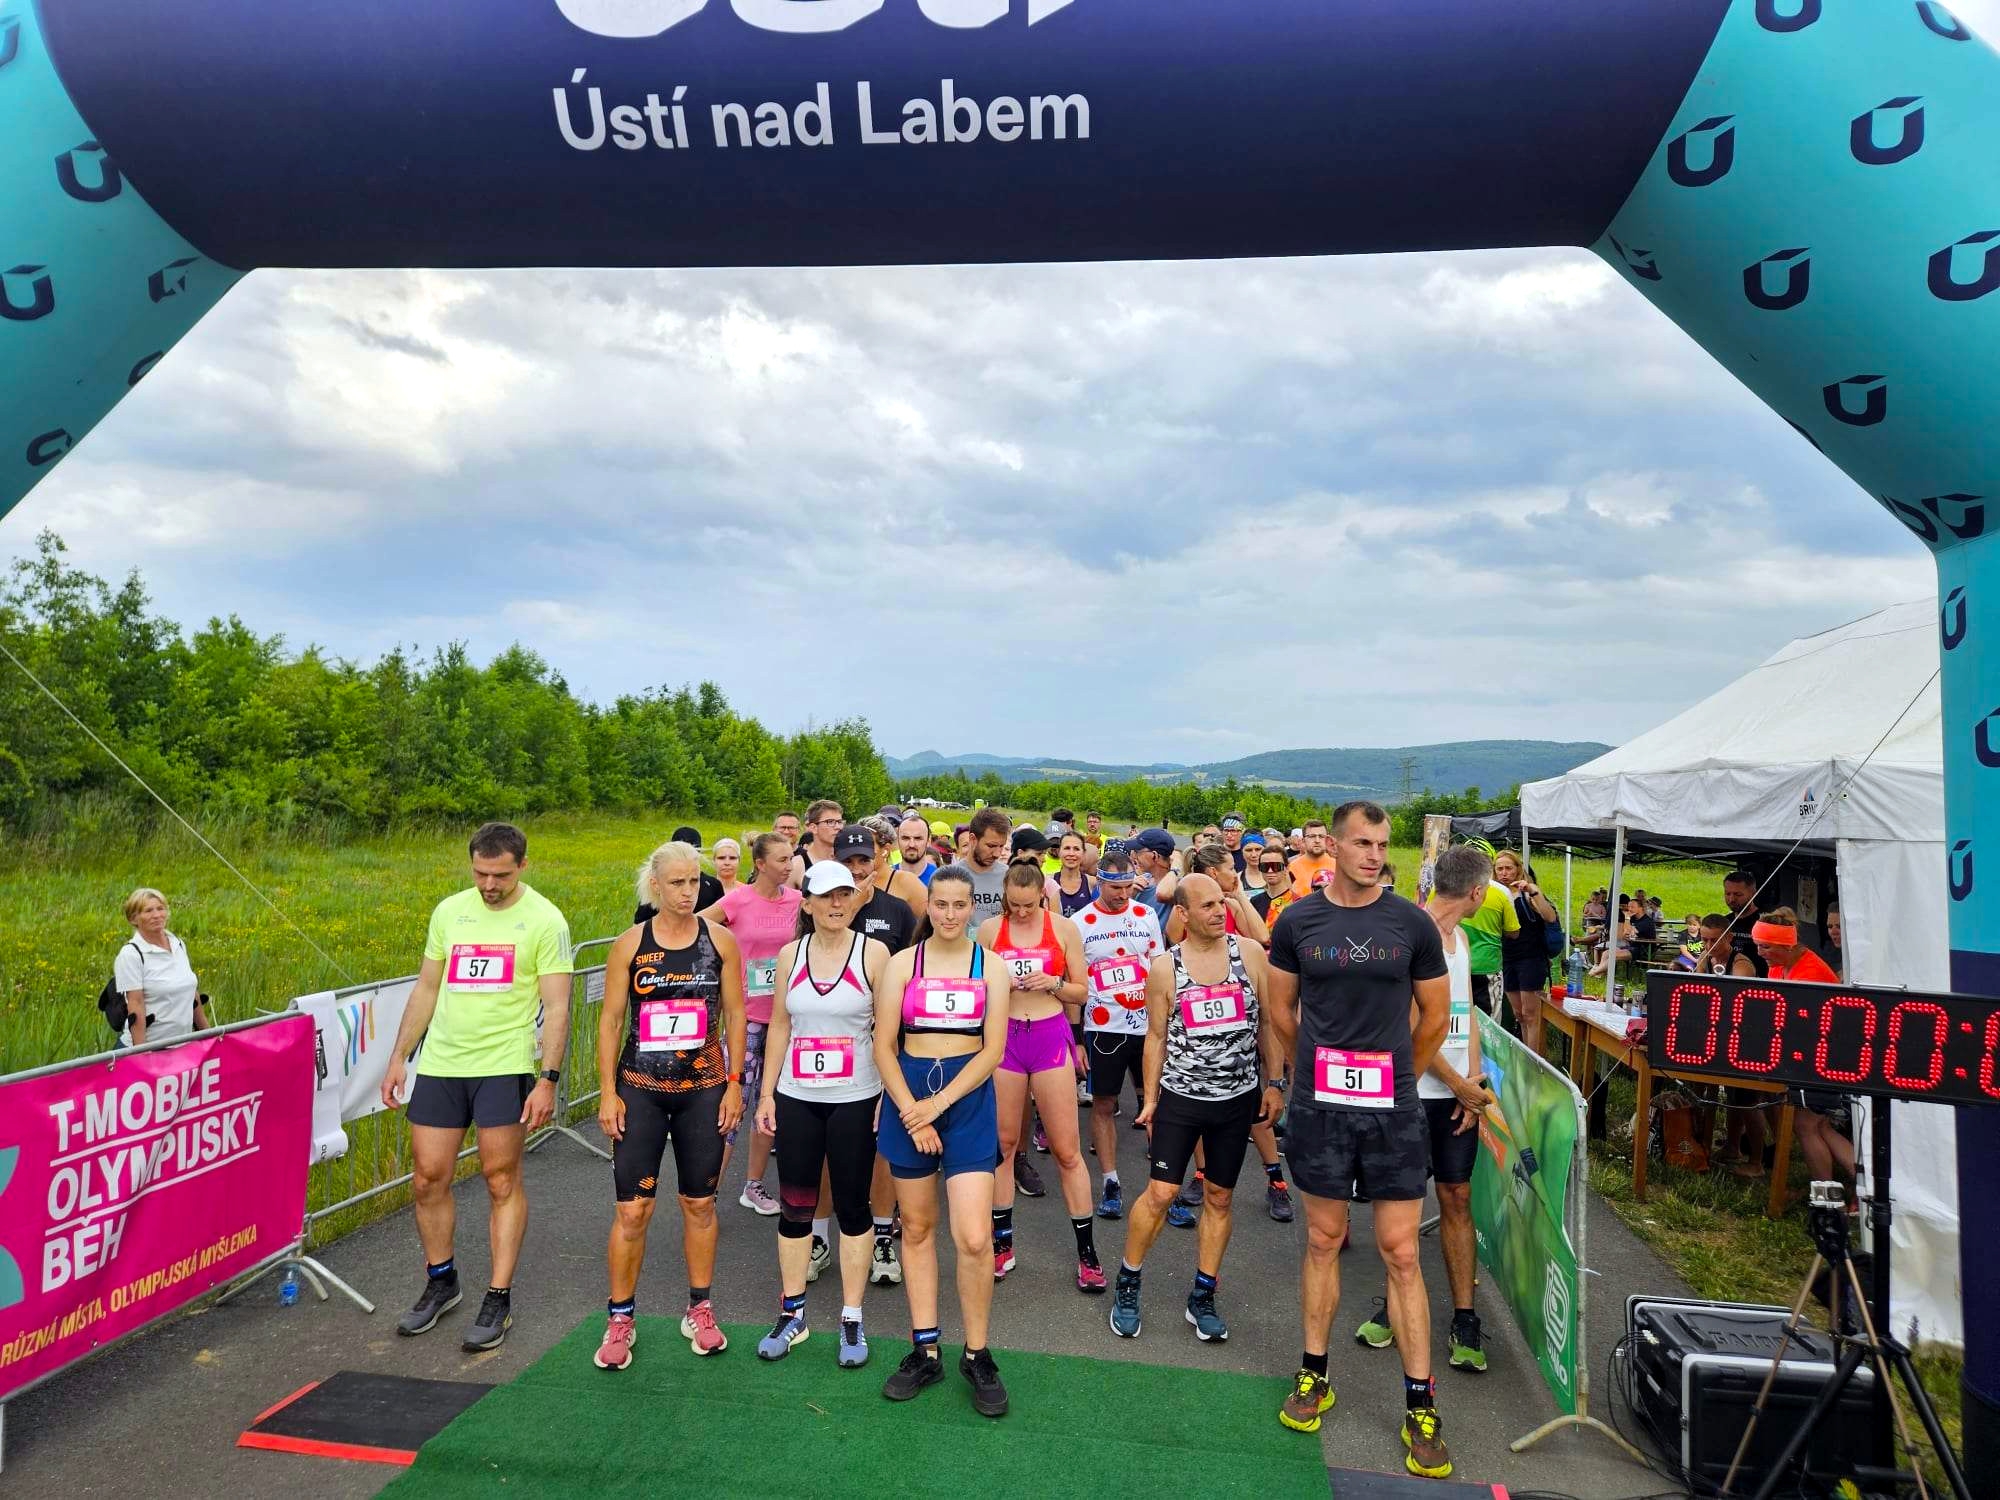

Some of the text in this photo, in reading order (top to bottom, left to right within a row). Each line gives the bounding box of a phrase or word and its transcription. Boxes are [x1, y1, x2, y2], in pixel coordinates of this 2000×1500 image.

[553, 68, 1090, 151] Ústí nad Labem
[469, 960, 489, 977] 57
[636, 952, 665, 965] SWEEP
[1015, 960, 1032, 977] 35
[1112, 968, 1125, 983] 13
[945, 993, 956, 1012] 5
[1204, 1000, 1224, 1020] 59
[669, 1015, 679, 1035] 7
[815, 1052, 824, 1072] 6
[1345, 1069, 1363, 1090] 51
[47, 1091, 262, 1221] OLYMPIJSKÝ
[42, 1212, 127, 1293] BĚH
[0, 1224, 258, 1368] RŮZNÁ MÍSTA, OLYMPIJSKÁ MYŠLENKA
